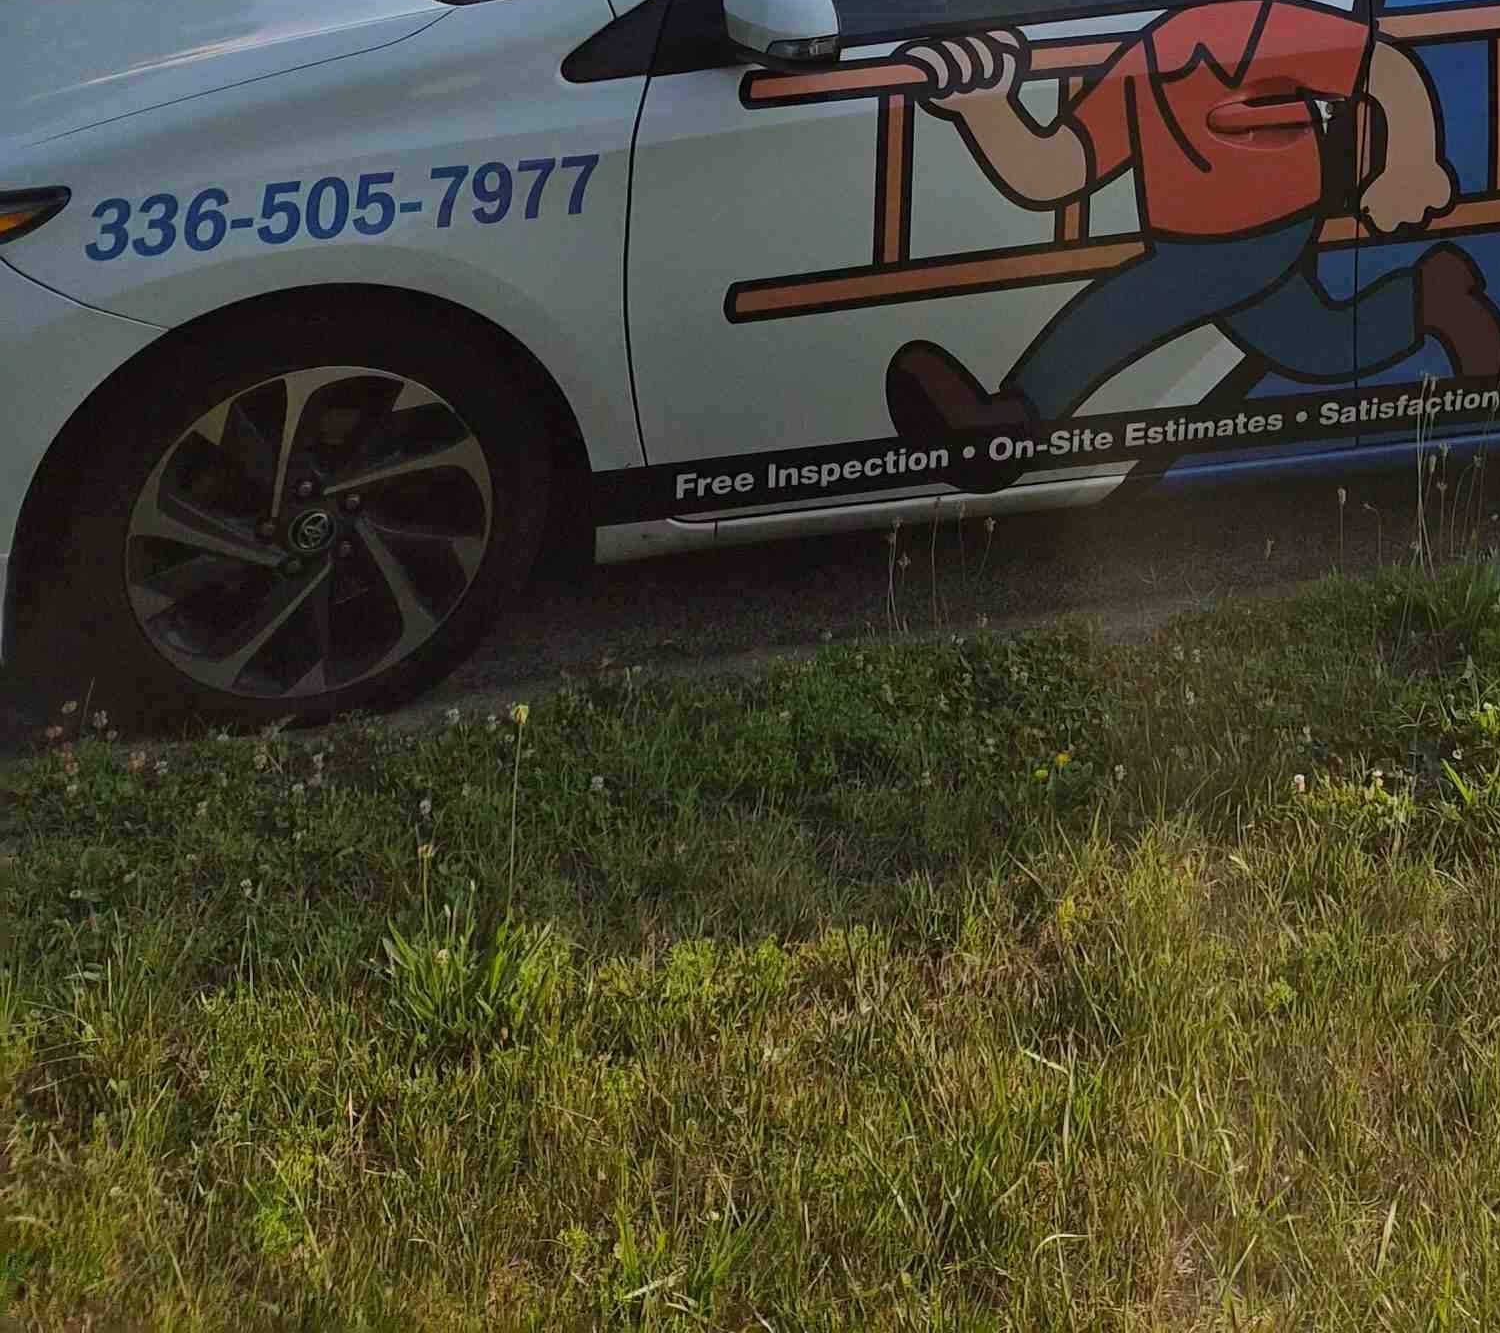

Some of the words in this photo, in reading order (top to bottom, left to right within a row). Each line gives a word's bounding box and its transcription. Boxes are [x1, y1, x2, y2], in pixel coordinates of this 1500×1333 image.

[84, 153, 600, 262] 336-505-7977
[675, 472, 754, 499] Free
[768, 447, 949, 488] Inspection
[989, 428, 1113, 460] On-Site
[1125, 412, 1283, 446] Estimates
[1319, 389, 1499, 425] Satisfaction
